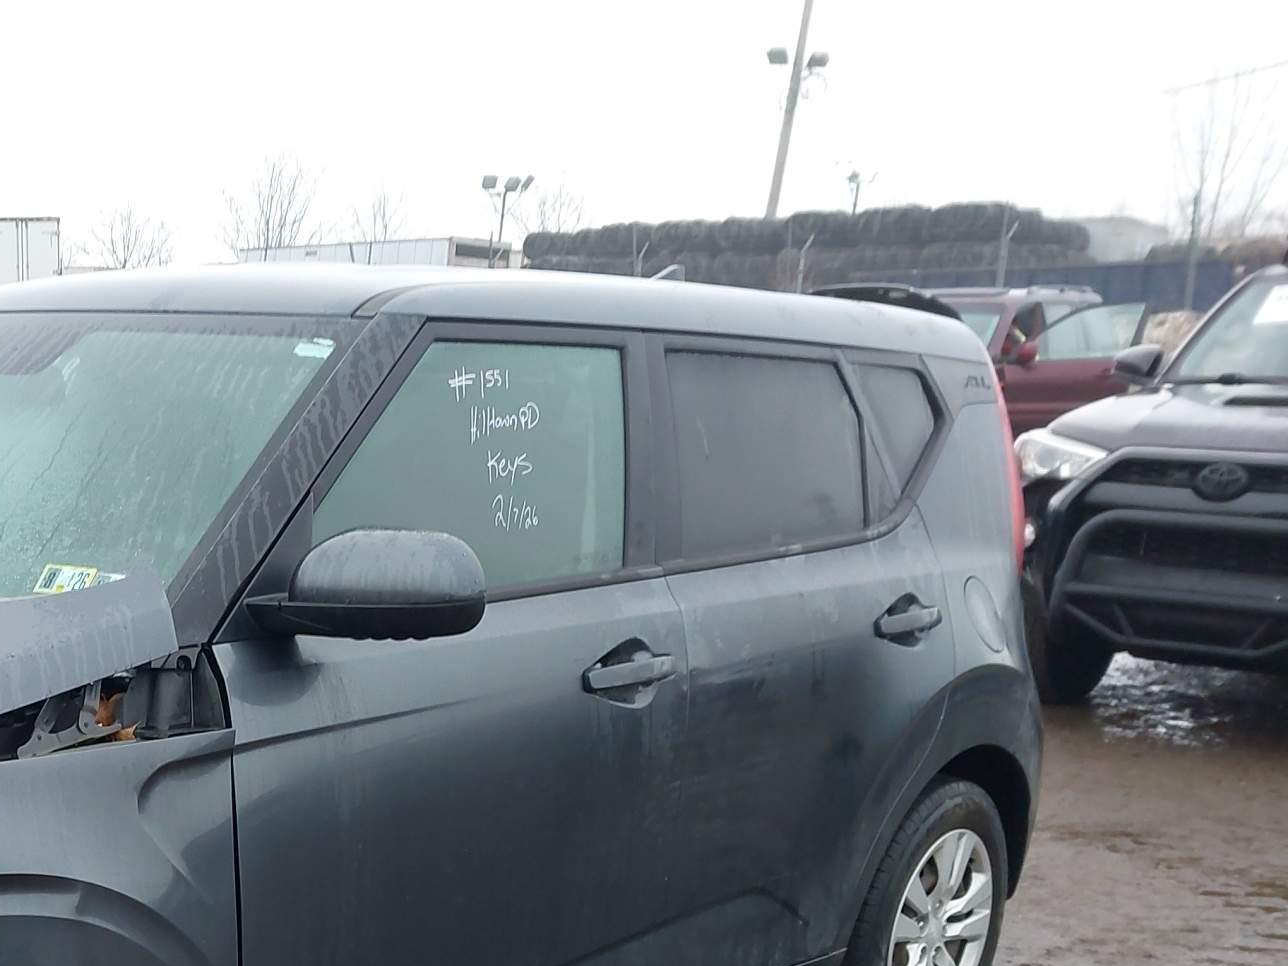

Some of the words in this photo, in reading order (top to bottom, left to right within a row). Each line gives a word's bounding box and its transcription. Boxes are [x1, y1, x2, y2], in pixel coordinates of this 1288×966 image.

[448, 366, 509, 402] #1551
[487, 450, 532, 486] Keys
[492, 494, 539, 532] 2/7/26
